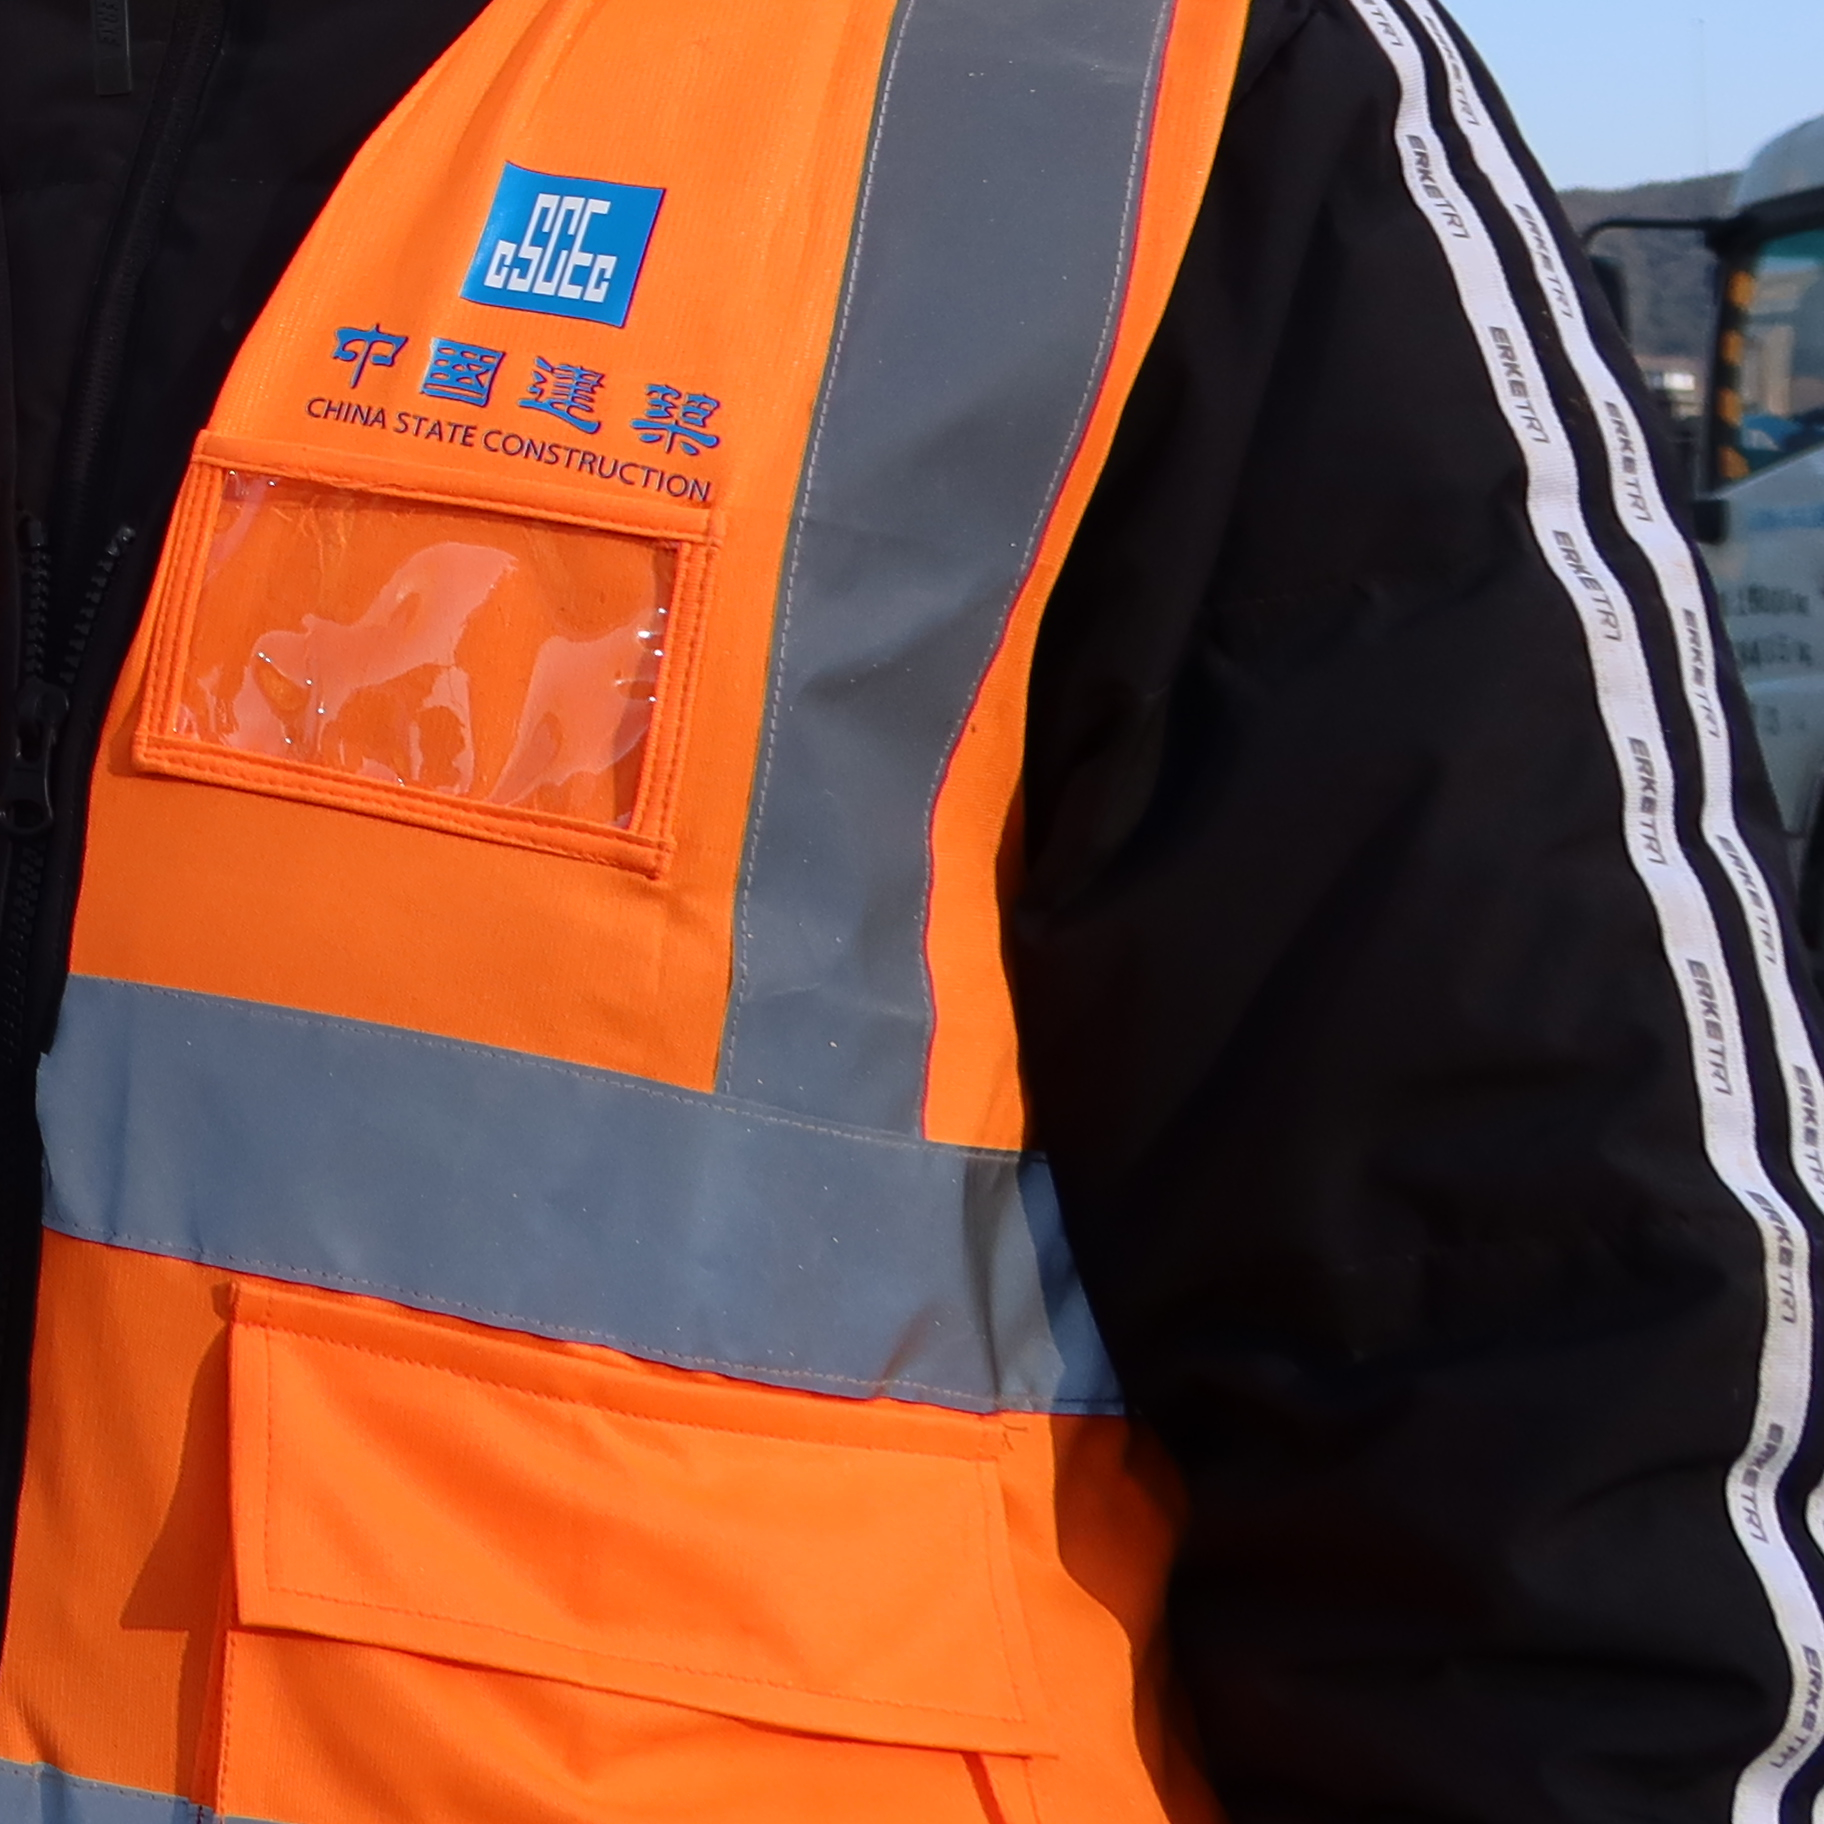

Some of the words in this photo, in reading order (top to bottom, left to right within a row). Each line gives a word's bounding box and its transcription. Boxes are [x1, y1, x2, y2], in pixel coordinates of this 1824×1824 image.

[306, 395, 387, 429] CHINA
[393, 411, 474, 447] STATE
[483, 428, 711, 502] CONSTRUCTION
